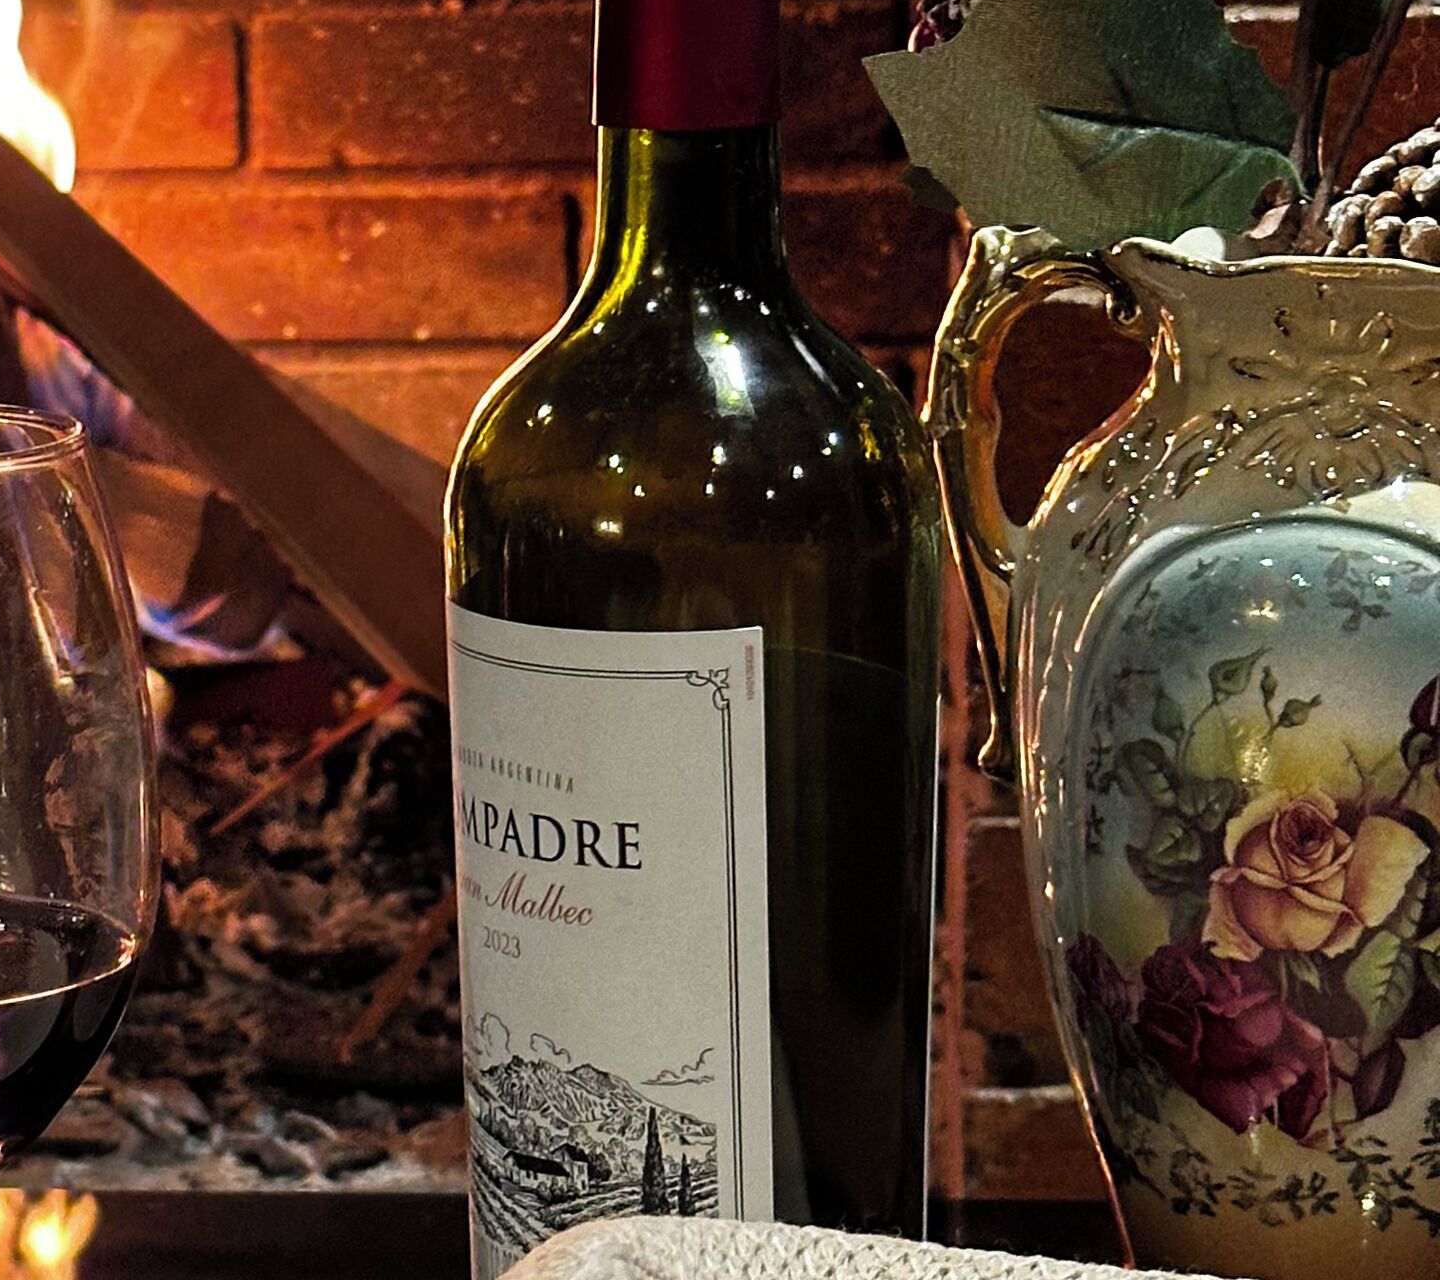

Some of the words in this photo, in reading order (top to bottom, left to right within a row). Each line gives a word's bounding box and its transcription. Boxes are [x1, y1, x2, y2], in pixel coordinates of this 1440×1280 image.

[490, 756, 574, 794] ARGENTINA
[458, 787, 643, 870] MPADRE
[485, 870, 593, 926] Malbec
[482, 926, 522, 959] 2023
